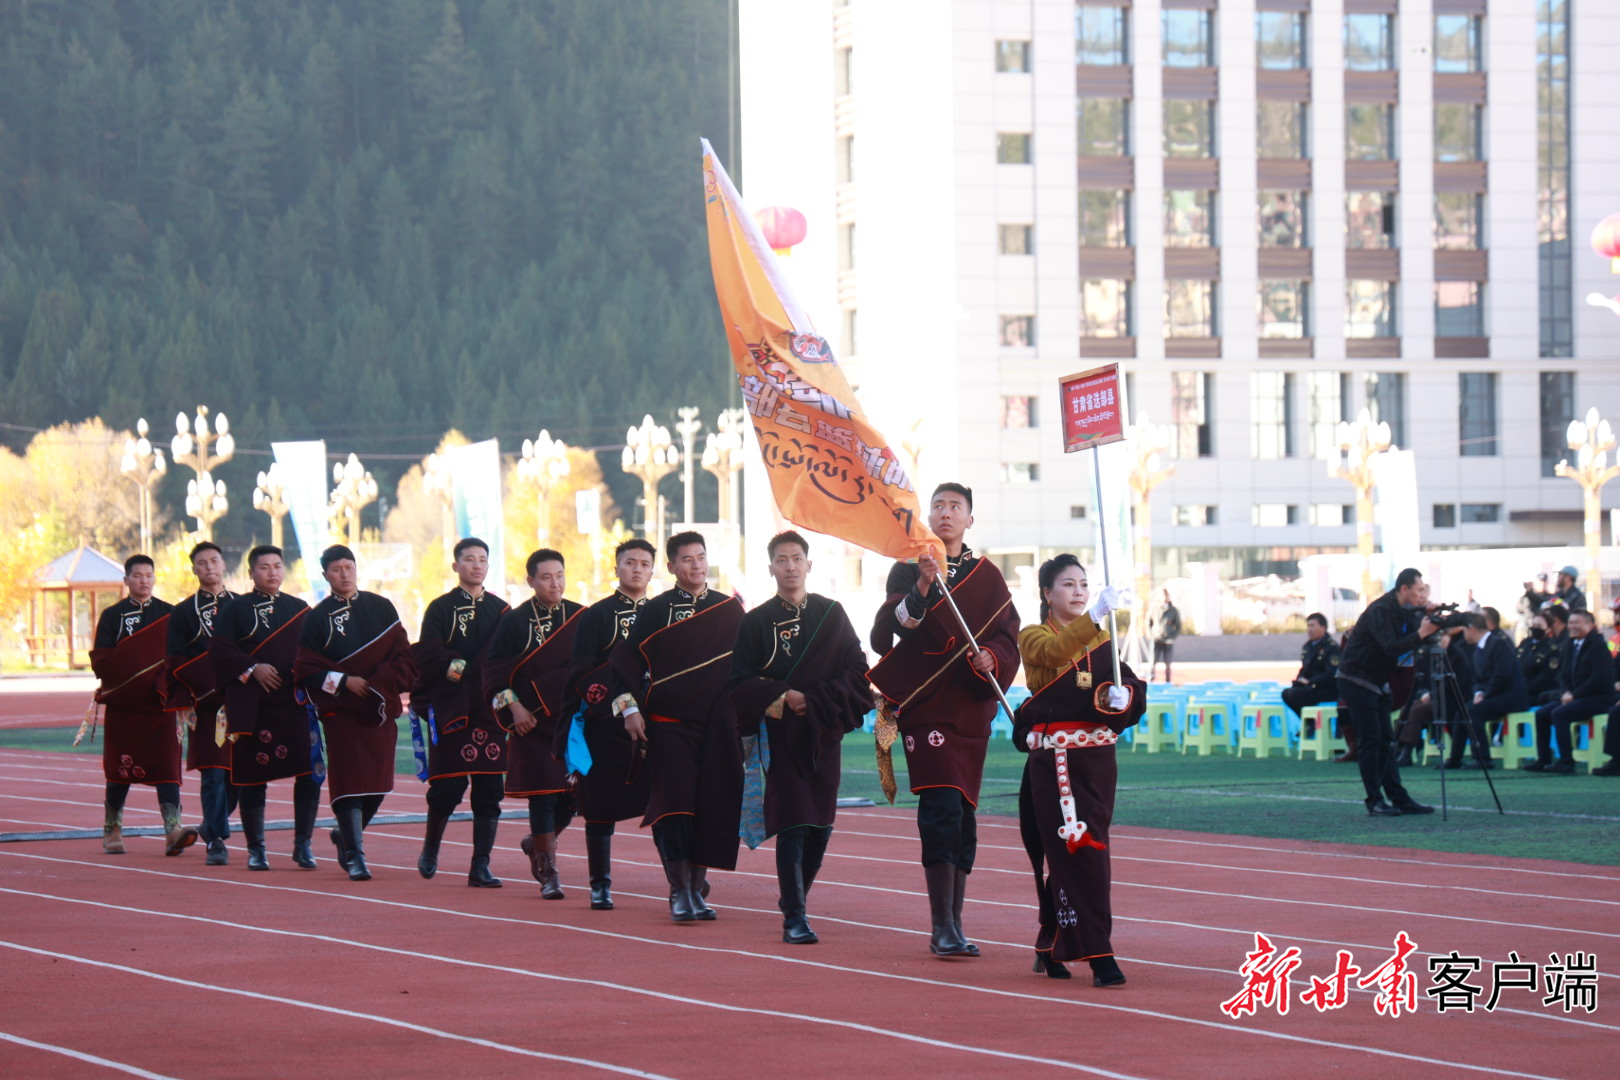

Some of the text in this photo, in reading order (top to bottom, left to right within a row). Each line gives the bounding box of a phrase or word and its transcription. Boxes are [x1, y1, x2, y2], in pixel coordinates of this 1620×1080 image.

[1072, 388, 1114, 414] 甘肃省迭部县
